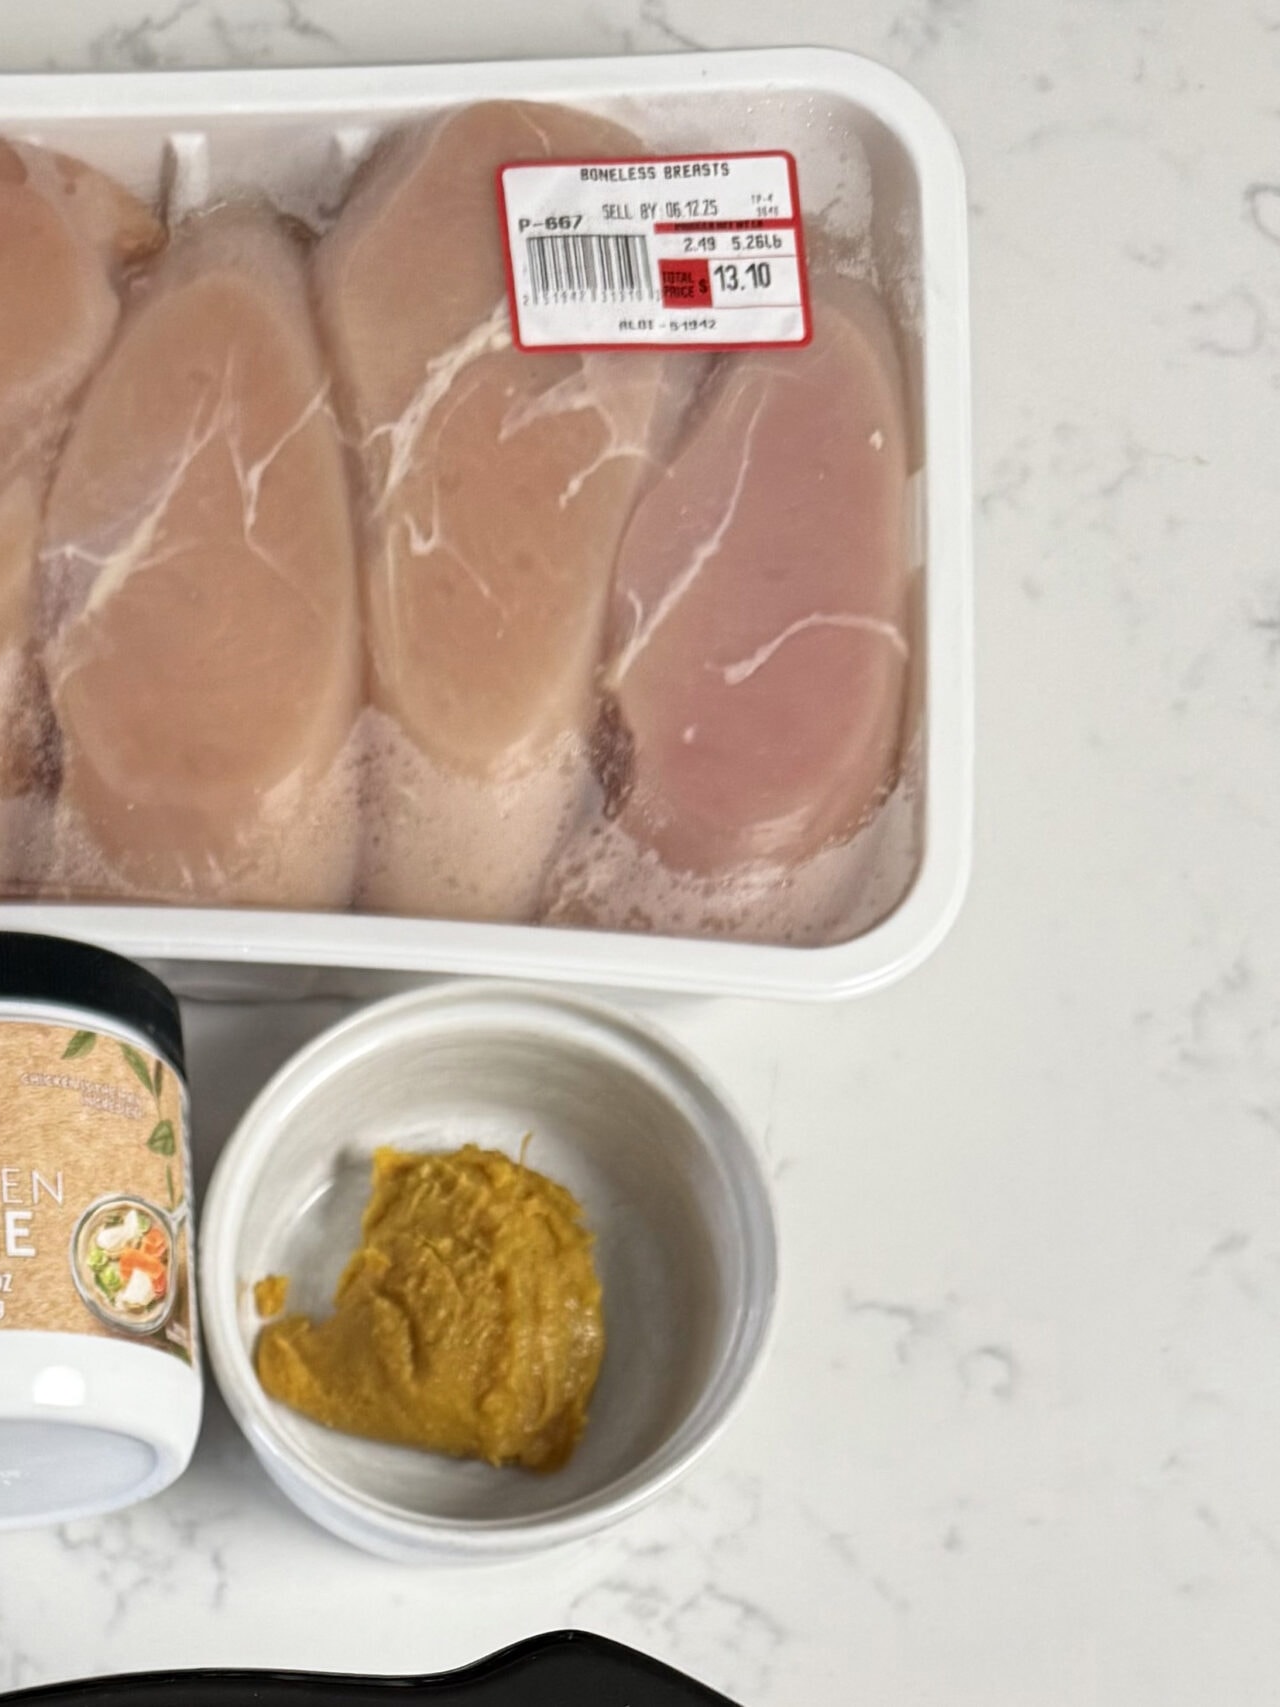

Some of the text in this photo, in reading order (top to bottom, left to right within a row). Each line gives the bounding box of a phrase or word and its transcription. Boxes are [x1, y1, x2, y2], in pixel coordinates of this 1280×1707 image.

[580, 162, 730, 182] BONELESS BREASTS
[602, 203, 633, 220] SELL
[640, 201, 658, 219] BY
[518, 215, 583, 233] P-667
[683, 236, 716, 252] 2.49
[662, 271, 694, 284] TOTAL
[714, 261, 772, 293] 13.10
[663, 278, 708, 298] PRICE $
